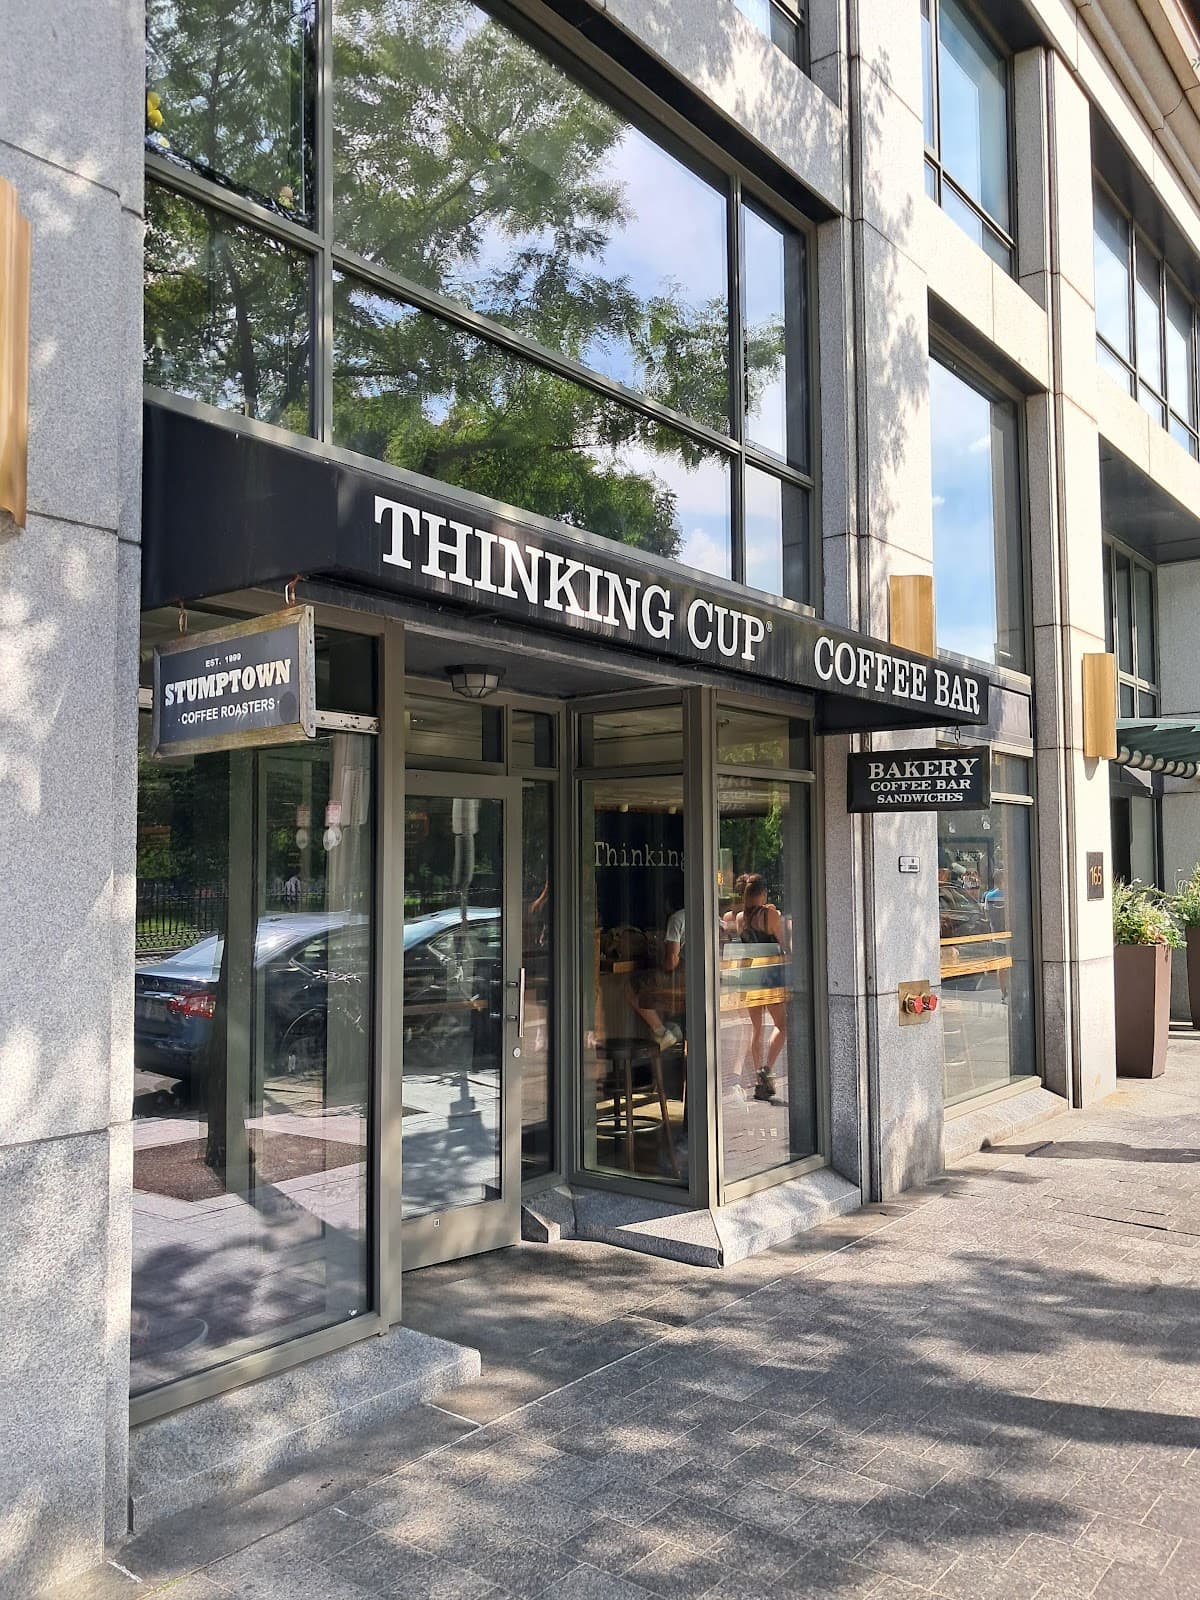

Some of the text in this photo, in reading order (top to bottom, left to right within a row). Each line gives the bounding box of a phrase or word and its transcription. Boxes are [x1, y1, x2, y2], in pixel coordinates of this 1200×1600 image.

[374, 495, 675, 640] THINKING
[205, 657, 221, 668] EST.
[165, 659, 291, 705] STUMPTOWN
[814, 636, 980, 715] COFFEE BAR
[182, 698, 275, 724] COFFEE ROASTERS
[867, 758, 979, 779] BAKERY
[870, 779, 971, 792] COFFEE BAR
[876, 792, 964, 804] SANDWICHES
[1090, 866, 1102, 885] 165
